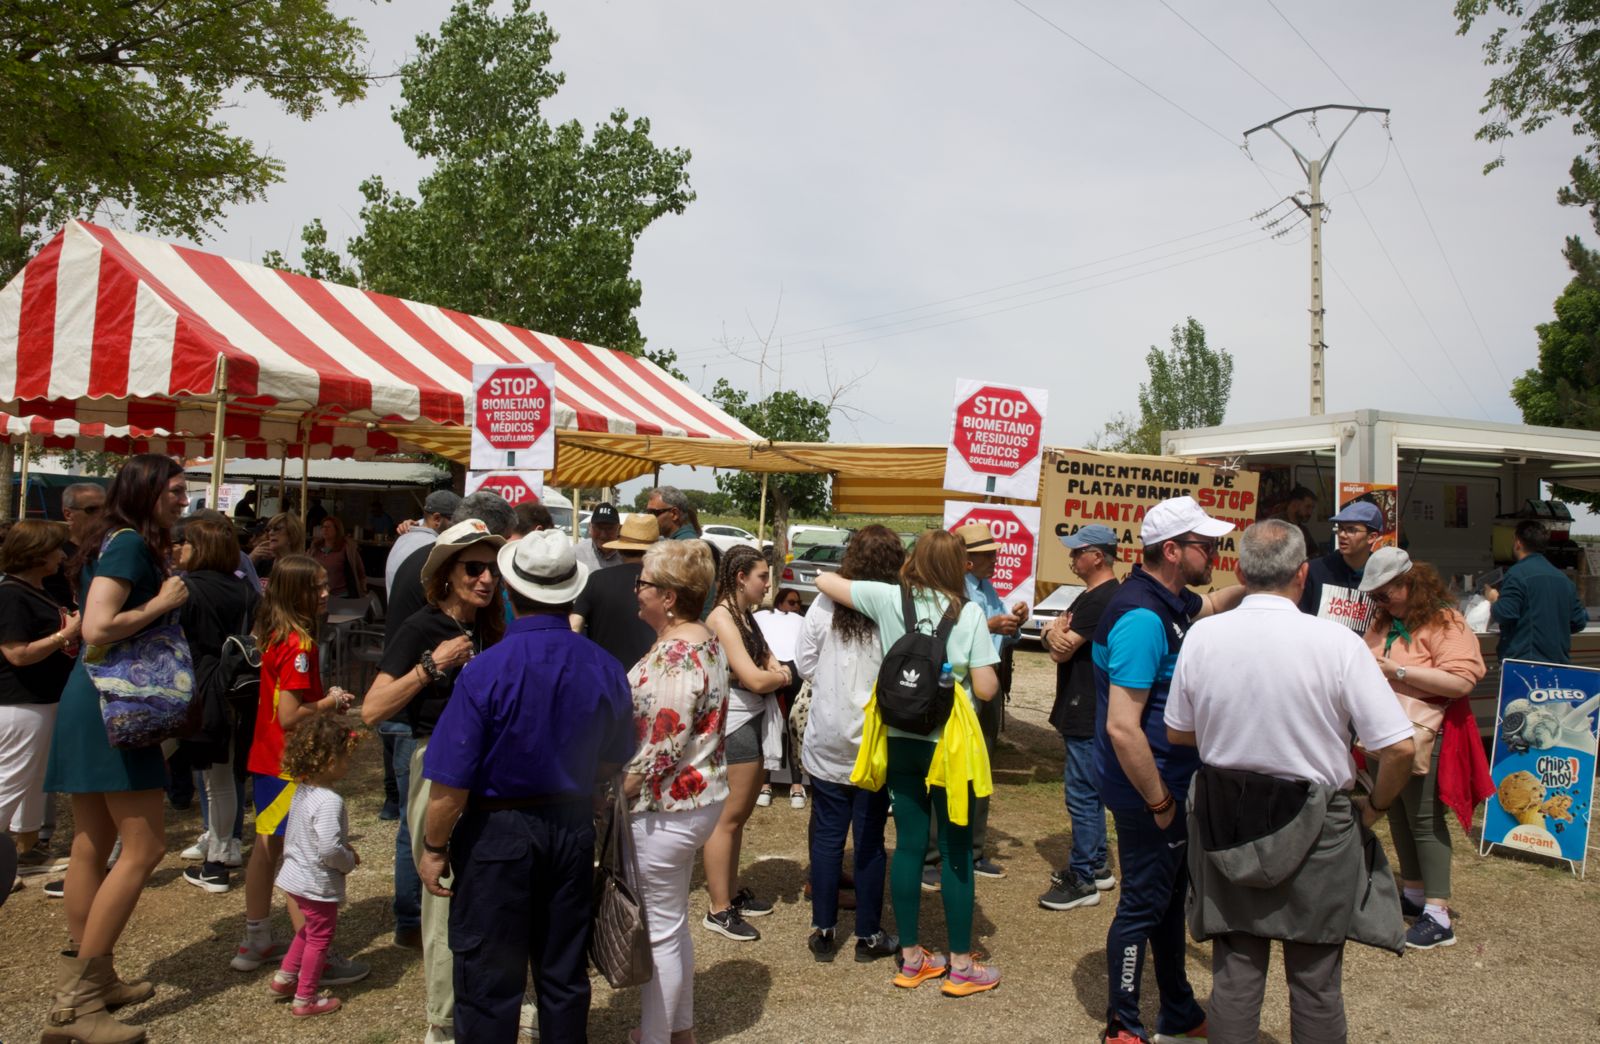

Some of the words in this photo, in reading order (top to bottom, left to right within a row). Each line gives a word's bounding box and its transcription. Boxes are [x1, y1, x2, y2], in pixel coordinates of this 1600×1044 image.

[490, 378, 538, 396] STOP
[482, 398, 545, 410] BIOMETANO
[974, 395, 1028, 419] STOP
[486, 413, 492, 421] Y
[494, 411, 541, 421] RESIDUOS
[491, 420, 534, 433] MÉDICOS
[963, 416, 1035, 436] BIOMETANO
[490, 433, 535, 442] SOCUÉLLAMOS
[966, 432, 973, 440] Y
[975, 431, 1028, 448] RESIDUOS
[970, 442, 1020, 459] MÉDICOS
[969, 456, 1020, 469] SOCUÉLLAMOS
[1213, 475, 1235, 489] DE
[1198, 488, 1255, 511] STOP
[1064, 499, 1153, 523] PLANTA
[1529, 689, 1585, 703] OREO
[1538, 756, 1571, 774] Chips
